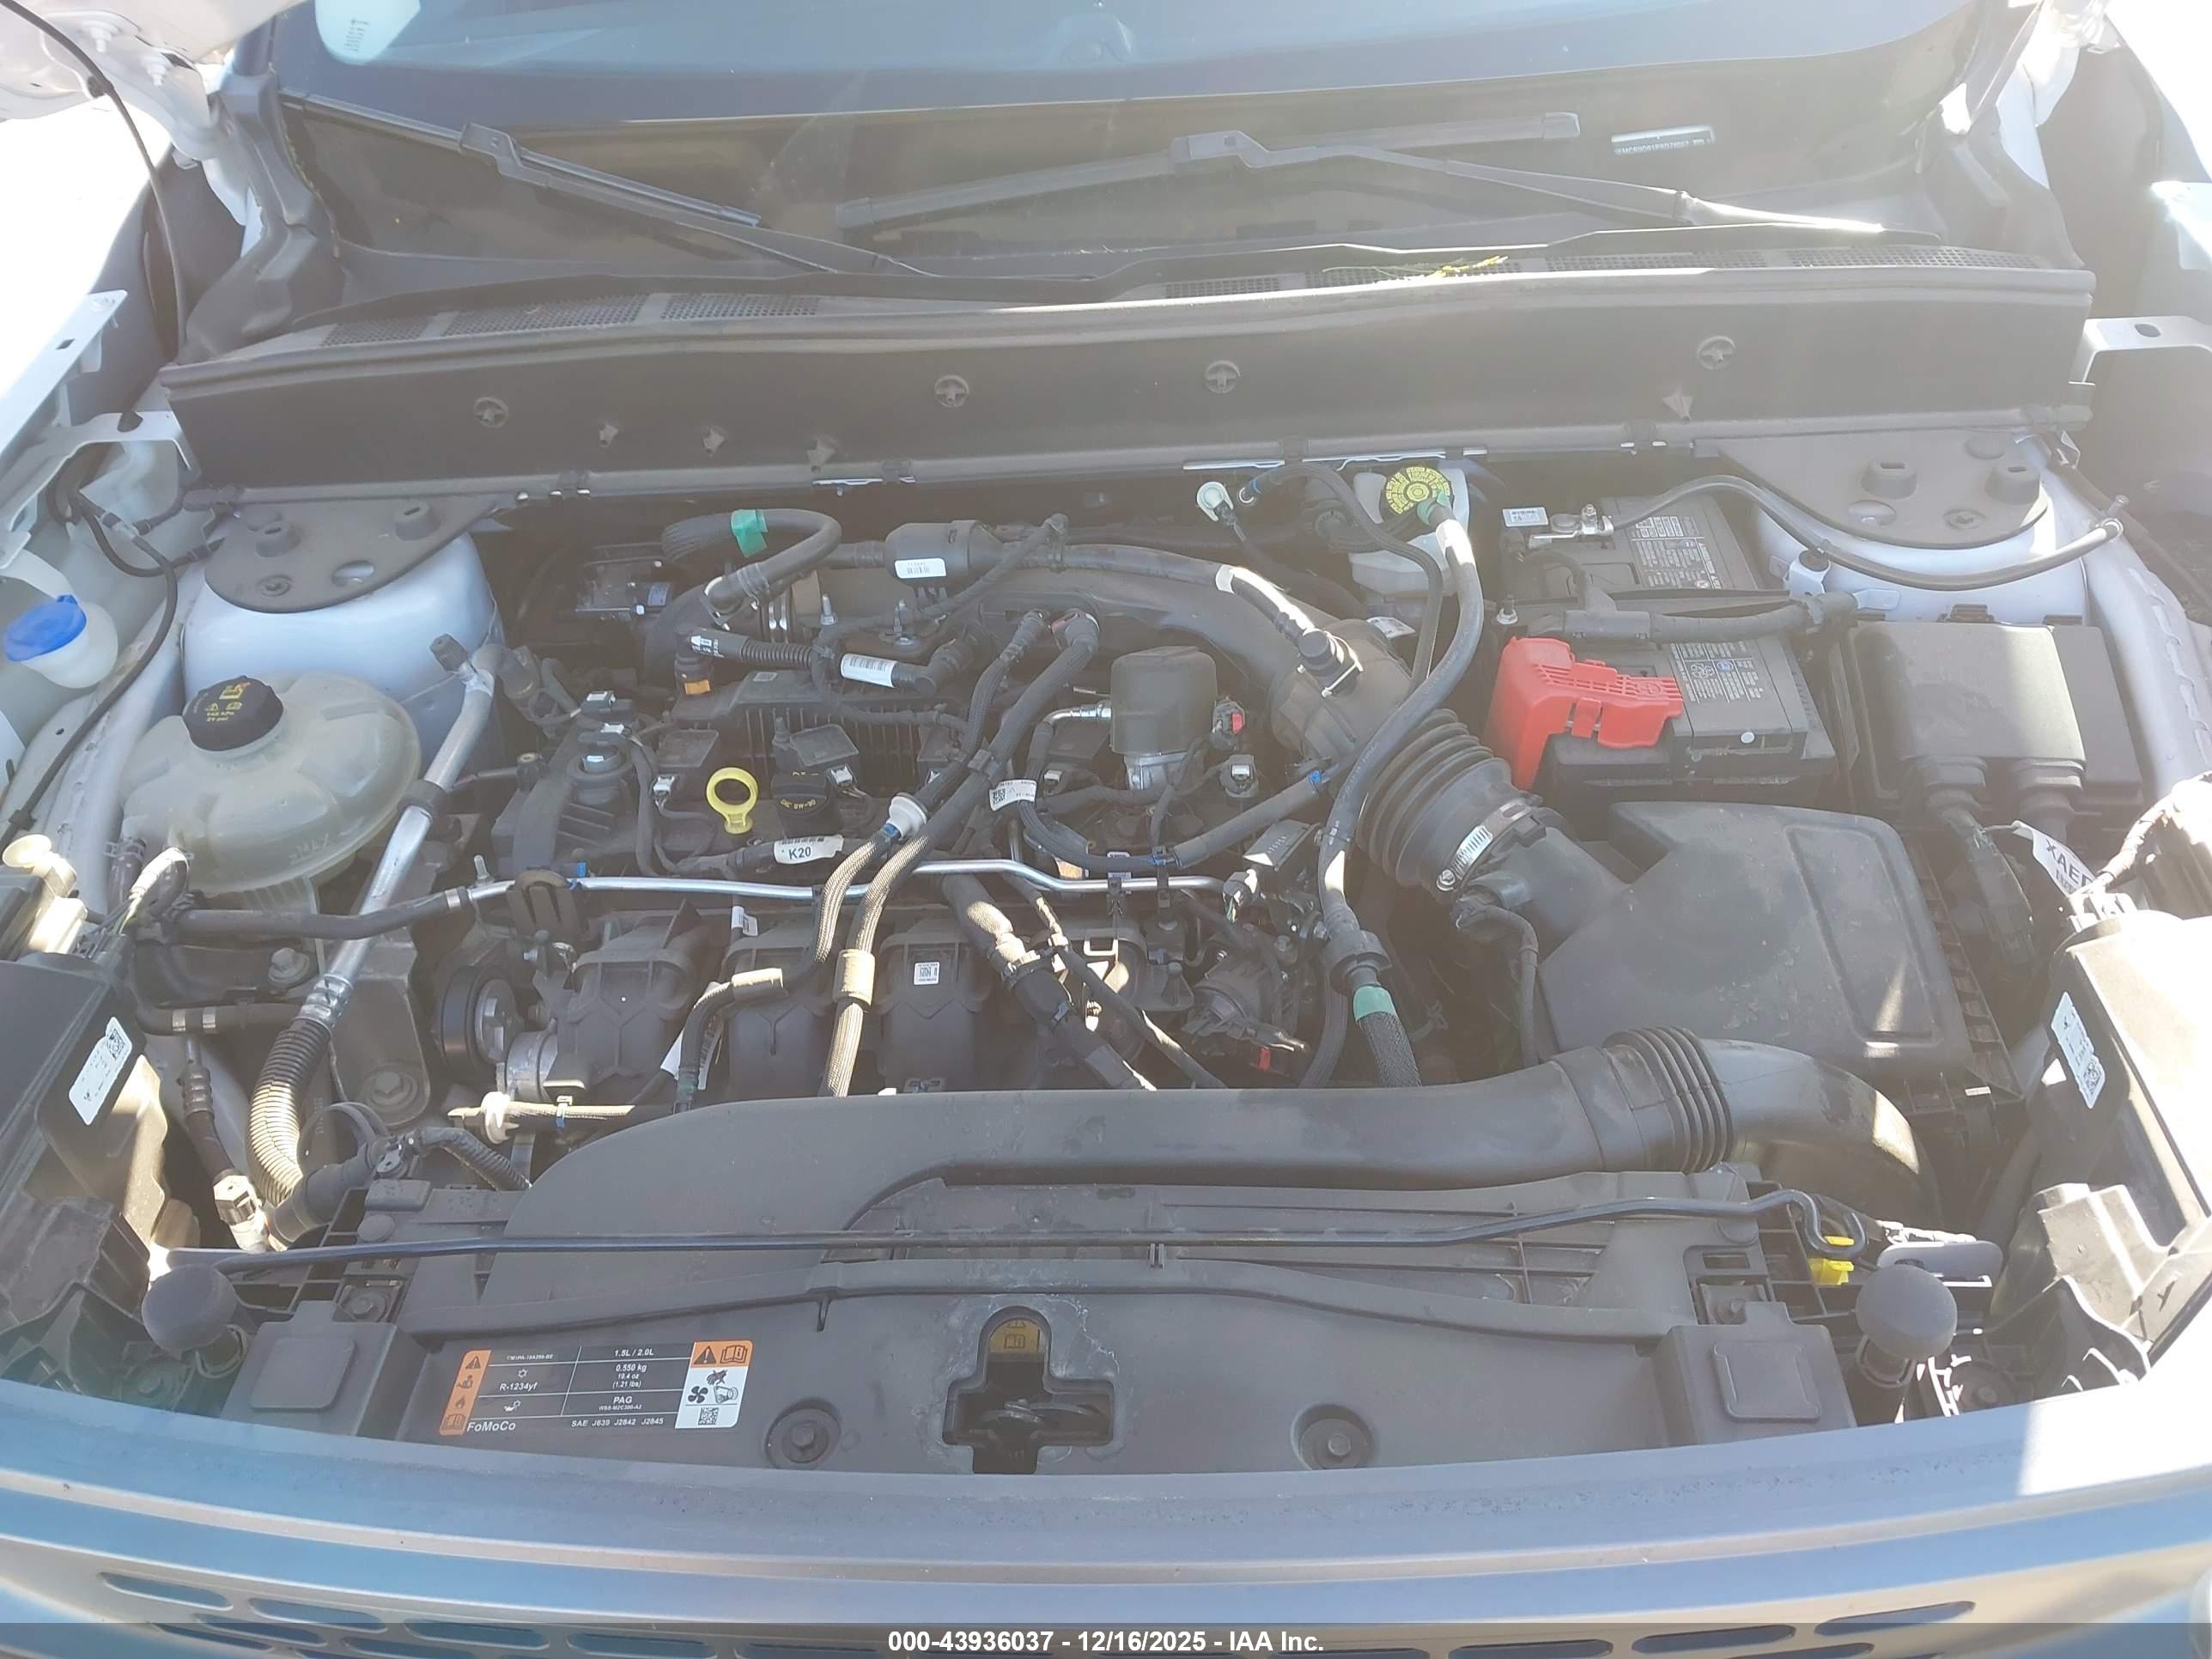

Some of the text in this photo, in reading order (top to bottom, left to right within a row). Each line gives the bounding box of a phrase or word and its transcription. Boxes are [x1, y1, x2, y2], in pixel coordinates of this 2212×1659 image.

[788, 847, 811, 860] K20
[615, 1363, 647, 1372] 0.550 kg
[499, 1382, 538, 1391] R-1234yf
[466, 1420, 516, 1432] FoMoCo
